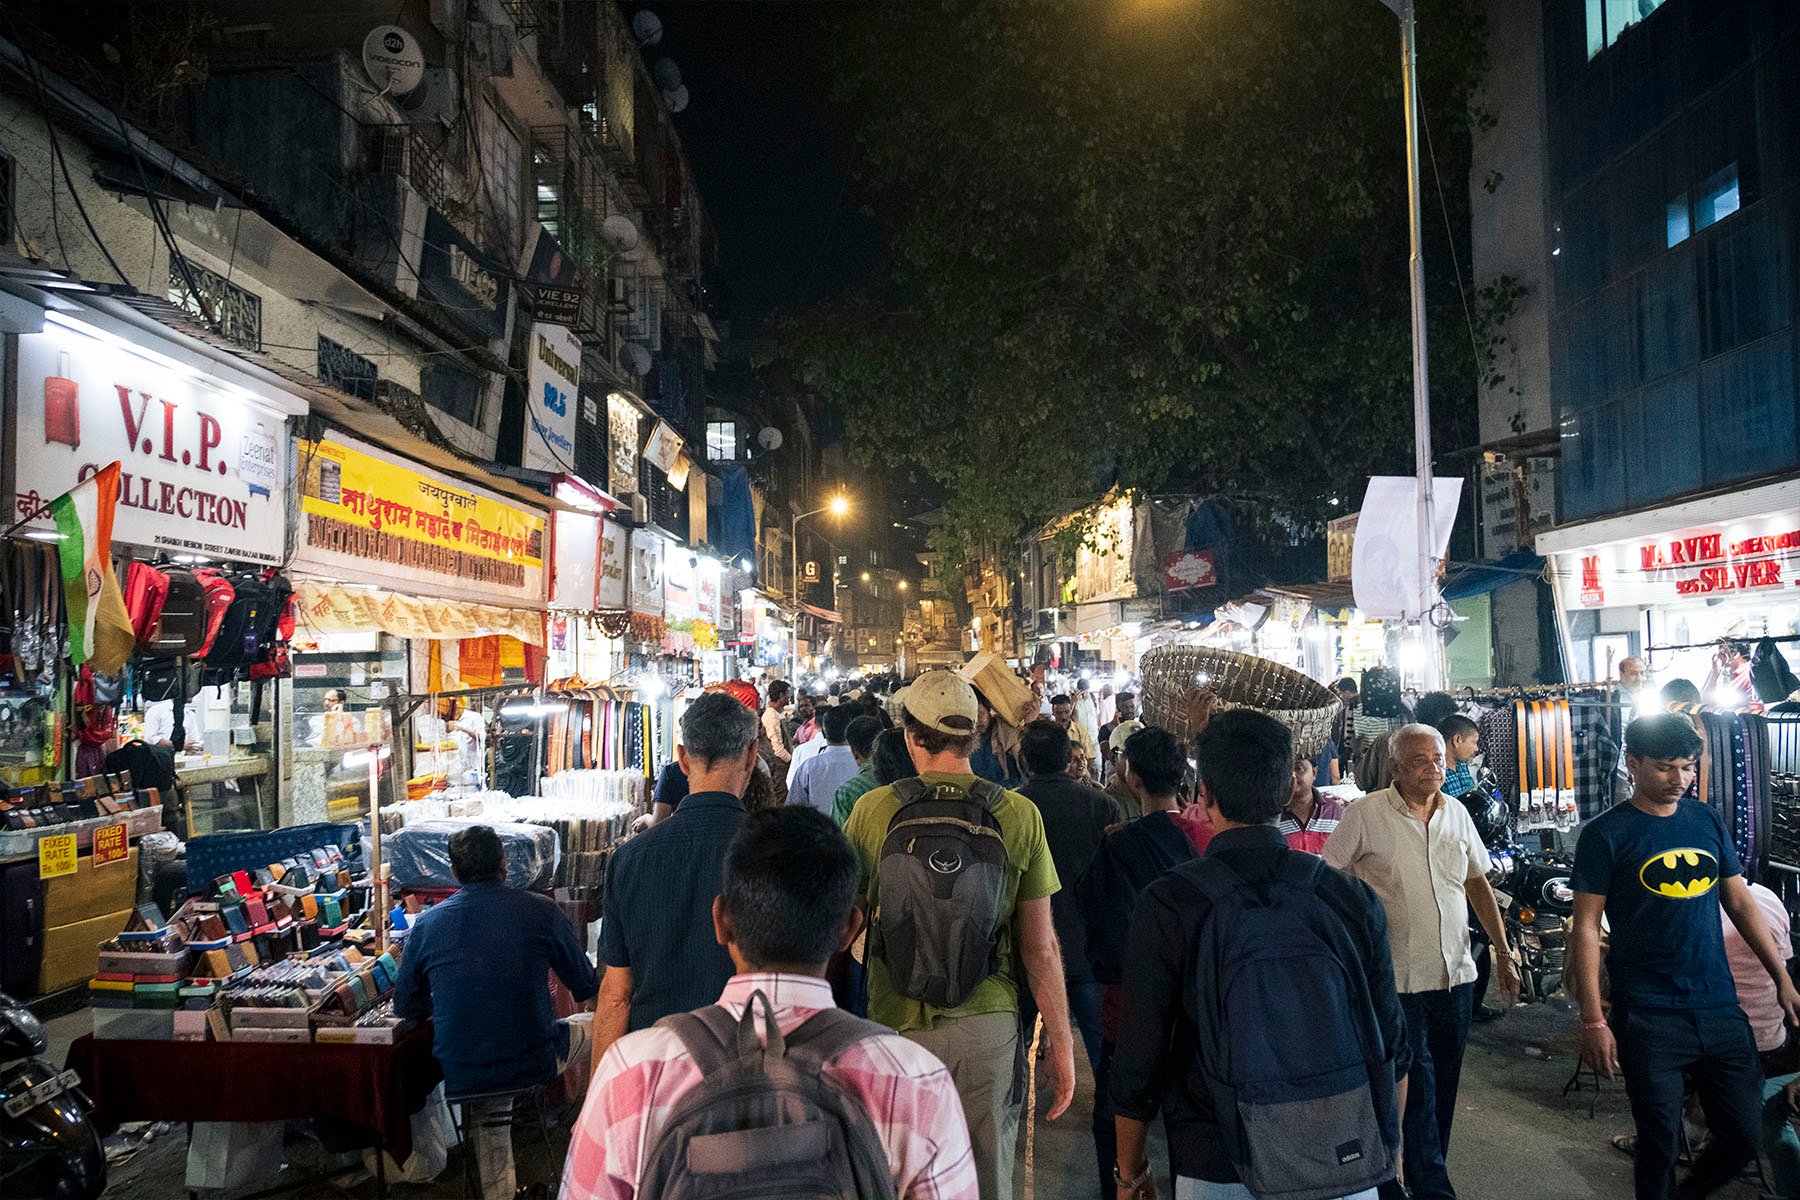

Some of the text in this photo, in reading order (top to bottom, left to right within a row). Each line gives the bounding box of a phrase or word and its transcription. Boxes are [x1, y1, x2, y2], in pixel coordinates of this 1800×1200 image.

[538, 288, 580, 304] VIE 92
[538, 332, 579, 387] Universal
[114, 384, 227, 476] V.I.P.
[341, 487, 412, 530] नाथुराम
[204, 543, 224, 553] STREET
[1640, 533, 1726, 571] MARVEL
[805, 561, 816, 576] G
[1700, 560, 1782, 592] SILVER
[97, 825, 123, 839] FIXED
[43, 838, 71, 849] FIXED
[98, 836, 122, 849] RATE
[45, 848, 70, 861] RATE
